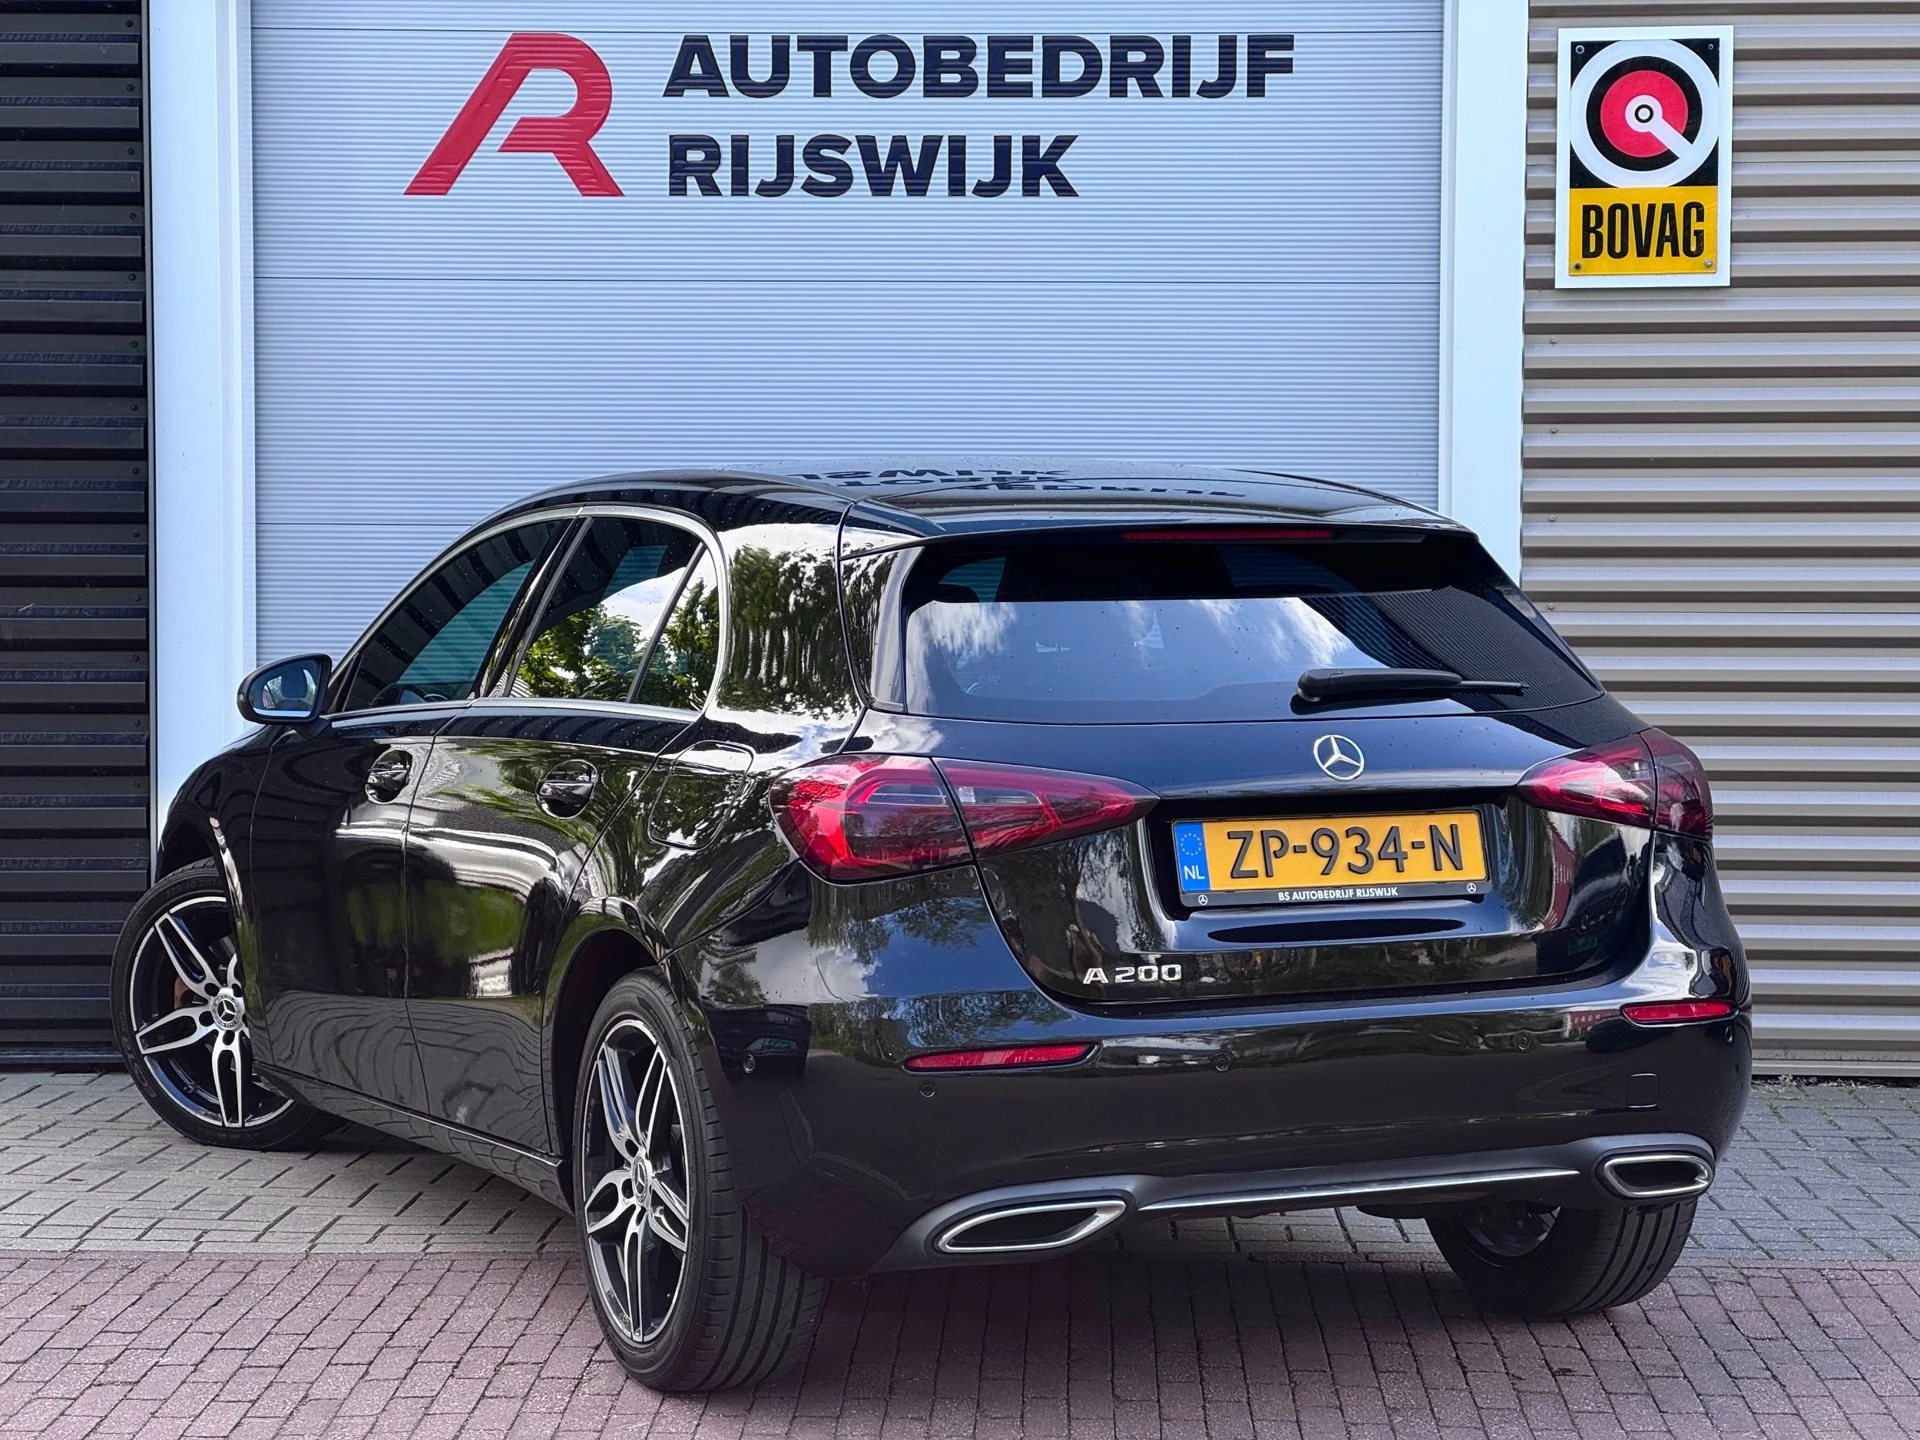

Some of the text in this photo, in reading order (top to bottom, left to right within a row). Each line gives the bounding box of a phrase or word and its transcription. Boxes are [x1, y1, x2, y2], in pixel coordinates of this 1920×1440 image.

[663, 34, 1294, 98] AUTOBEDRIJF
[669, 134, 1079, 198] RIJSWIJK
[1582, 201, 1705, 259] BOVAG
[1183, 864, 1206, 881] NL
[1227, 823, 1464, 880] ZP-934-N
[1278, 887, 1398, 901] BS AUTOBEDRIJF RIJSWIJK
[1082, 964, 1182, 985] A 200
